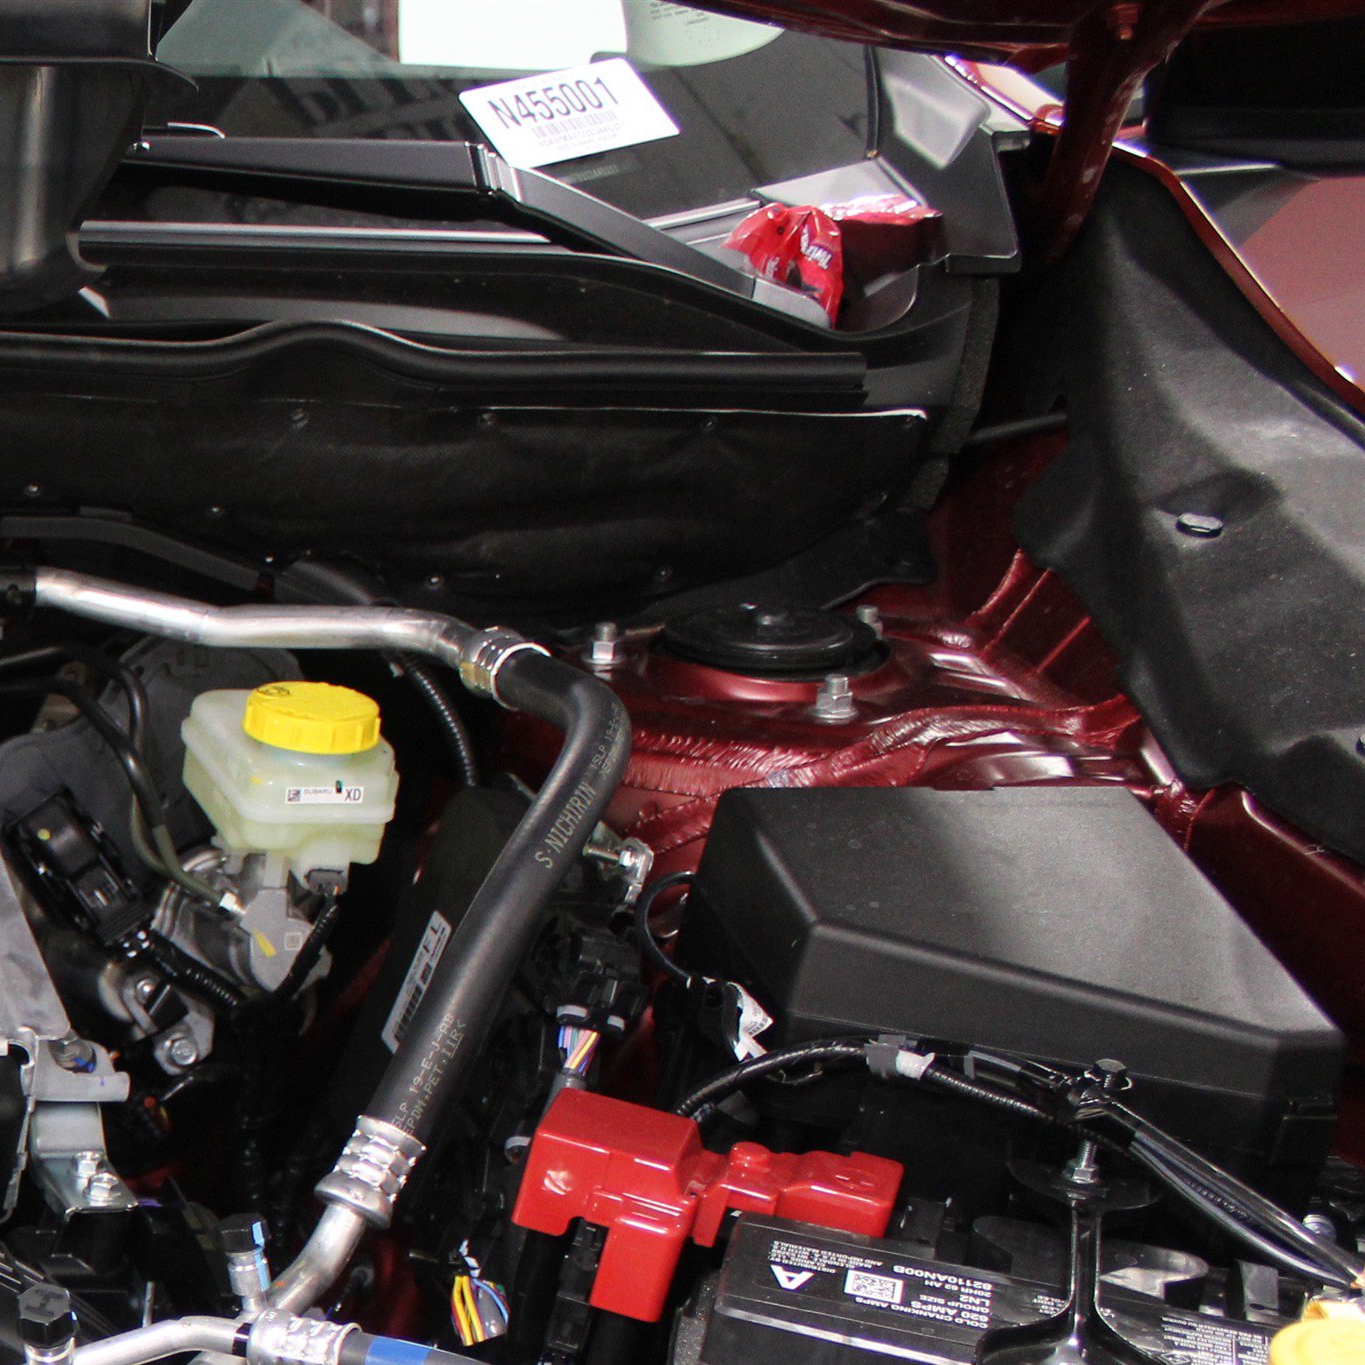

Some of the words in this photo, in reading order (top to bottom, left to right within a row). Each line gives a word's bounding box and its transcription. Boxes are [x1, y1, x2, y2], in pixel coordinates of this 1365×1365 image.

[487, 76, 619, 130] N455001
[344, 788, 362, 802] XD
[773, 1240, 819, 1253] MATERIALS
[820, 1250, 863, 1262] IMPORTED
[864, 1258, 882, 1266] AND
[781, 1259, 835, 1273] DISTRIBUTED
[848, 1260, 871, 1268] MADE
[892, 1265, 993, 1290] 82110AN00B
[924, 1279, 943, 1288] AH
[944, 1283, 959, 1291] 62
[959, 1286, 992, 1298] 20HR
[855, 1296, 889, 1308] AMPS
[919, 1294, 946, 1304] SIZE
[959, 1294, 991, 1307] LN2
[891, 1304, 953, 1322] CRANKING
[910, 1300, 959, 1316] AMPS
[947, 1301, 990, 1314] GROUP
[960, 1310, 989, 1322] 620
[954, 1317, 989, 1329] COLD
